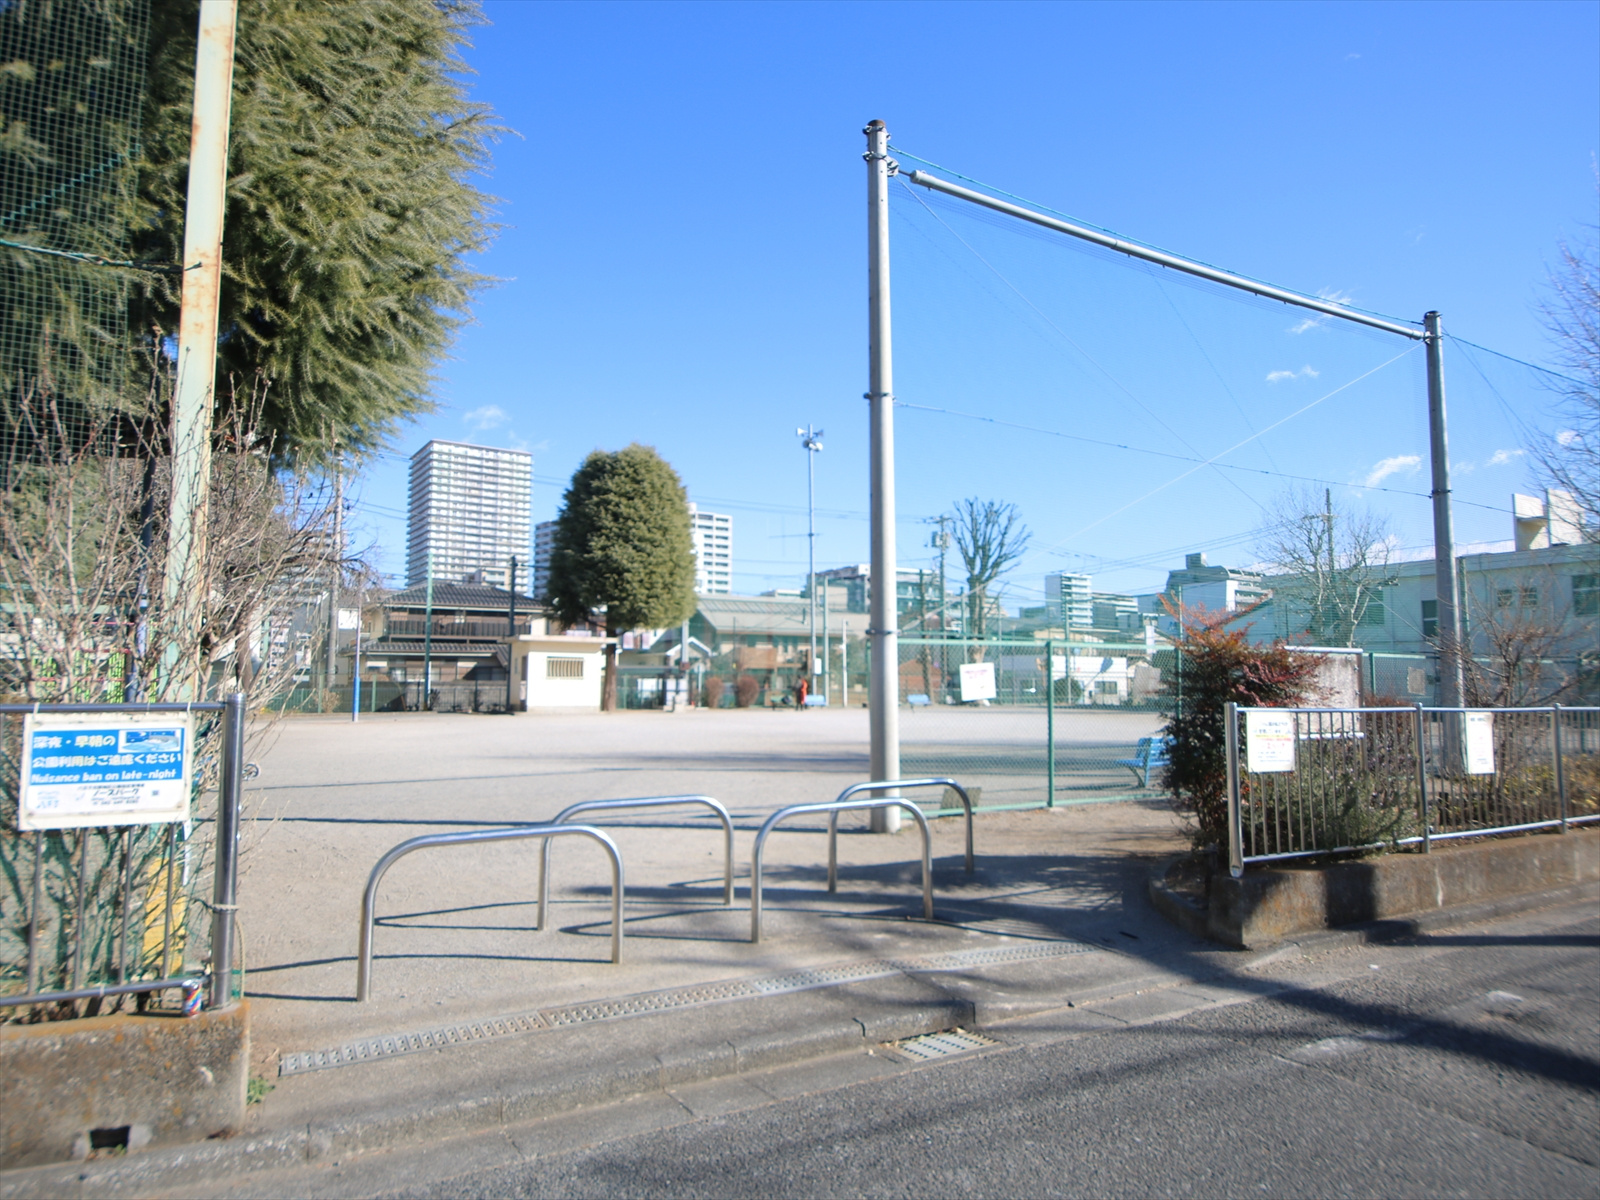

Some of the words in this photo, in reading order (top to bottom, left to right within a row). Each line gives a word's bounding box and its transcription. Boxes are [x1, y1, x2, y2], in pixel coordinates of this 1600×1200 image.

[33, 736, 116, 749] 深夜・早朝の
[32, 753, 181, 768] 公園利用はご遠慮ください
[31, 773, 79, 783] Nuisance
[82, 772, 102, 781] ban
[122, 769, 176, 780] late-night
